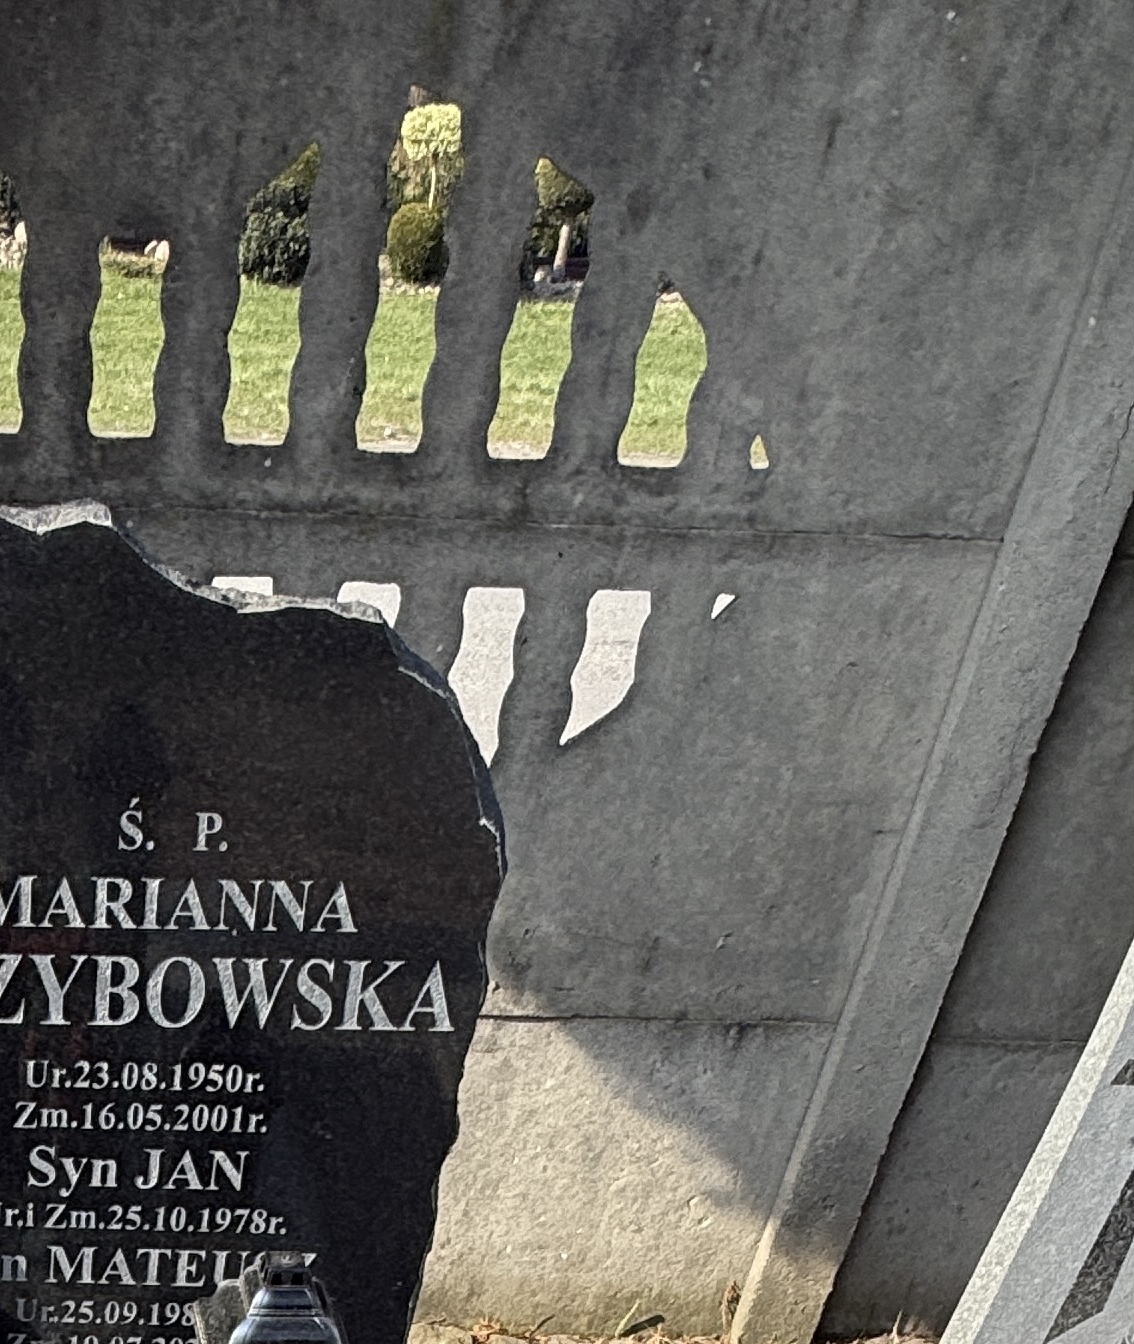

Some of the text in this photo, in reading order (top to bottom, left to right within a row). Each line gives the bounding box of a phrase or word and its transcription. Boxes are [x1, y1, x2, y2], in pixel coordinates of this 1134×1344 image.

[117, 797, 228, 852] Ś. P.
[24, 1059, 265, 1093] Ur.23.08.1950r.
[13, 1101, 267, 1133] Zm.16.05.2001r.
[27, 1145, 250, 1197] Syn JAN
[44, 1203, 287, 1235] Zm.25.10.1978r.
[44, 1245, 317, 1287] MATEU
[16, 1298, 196, 1327] Ur.25.09.198
